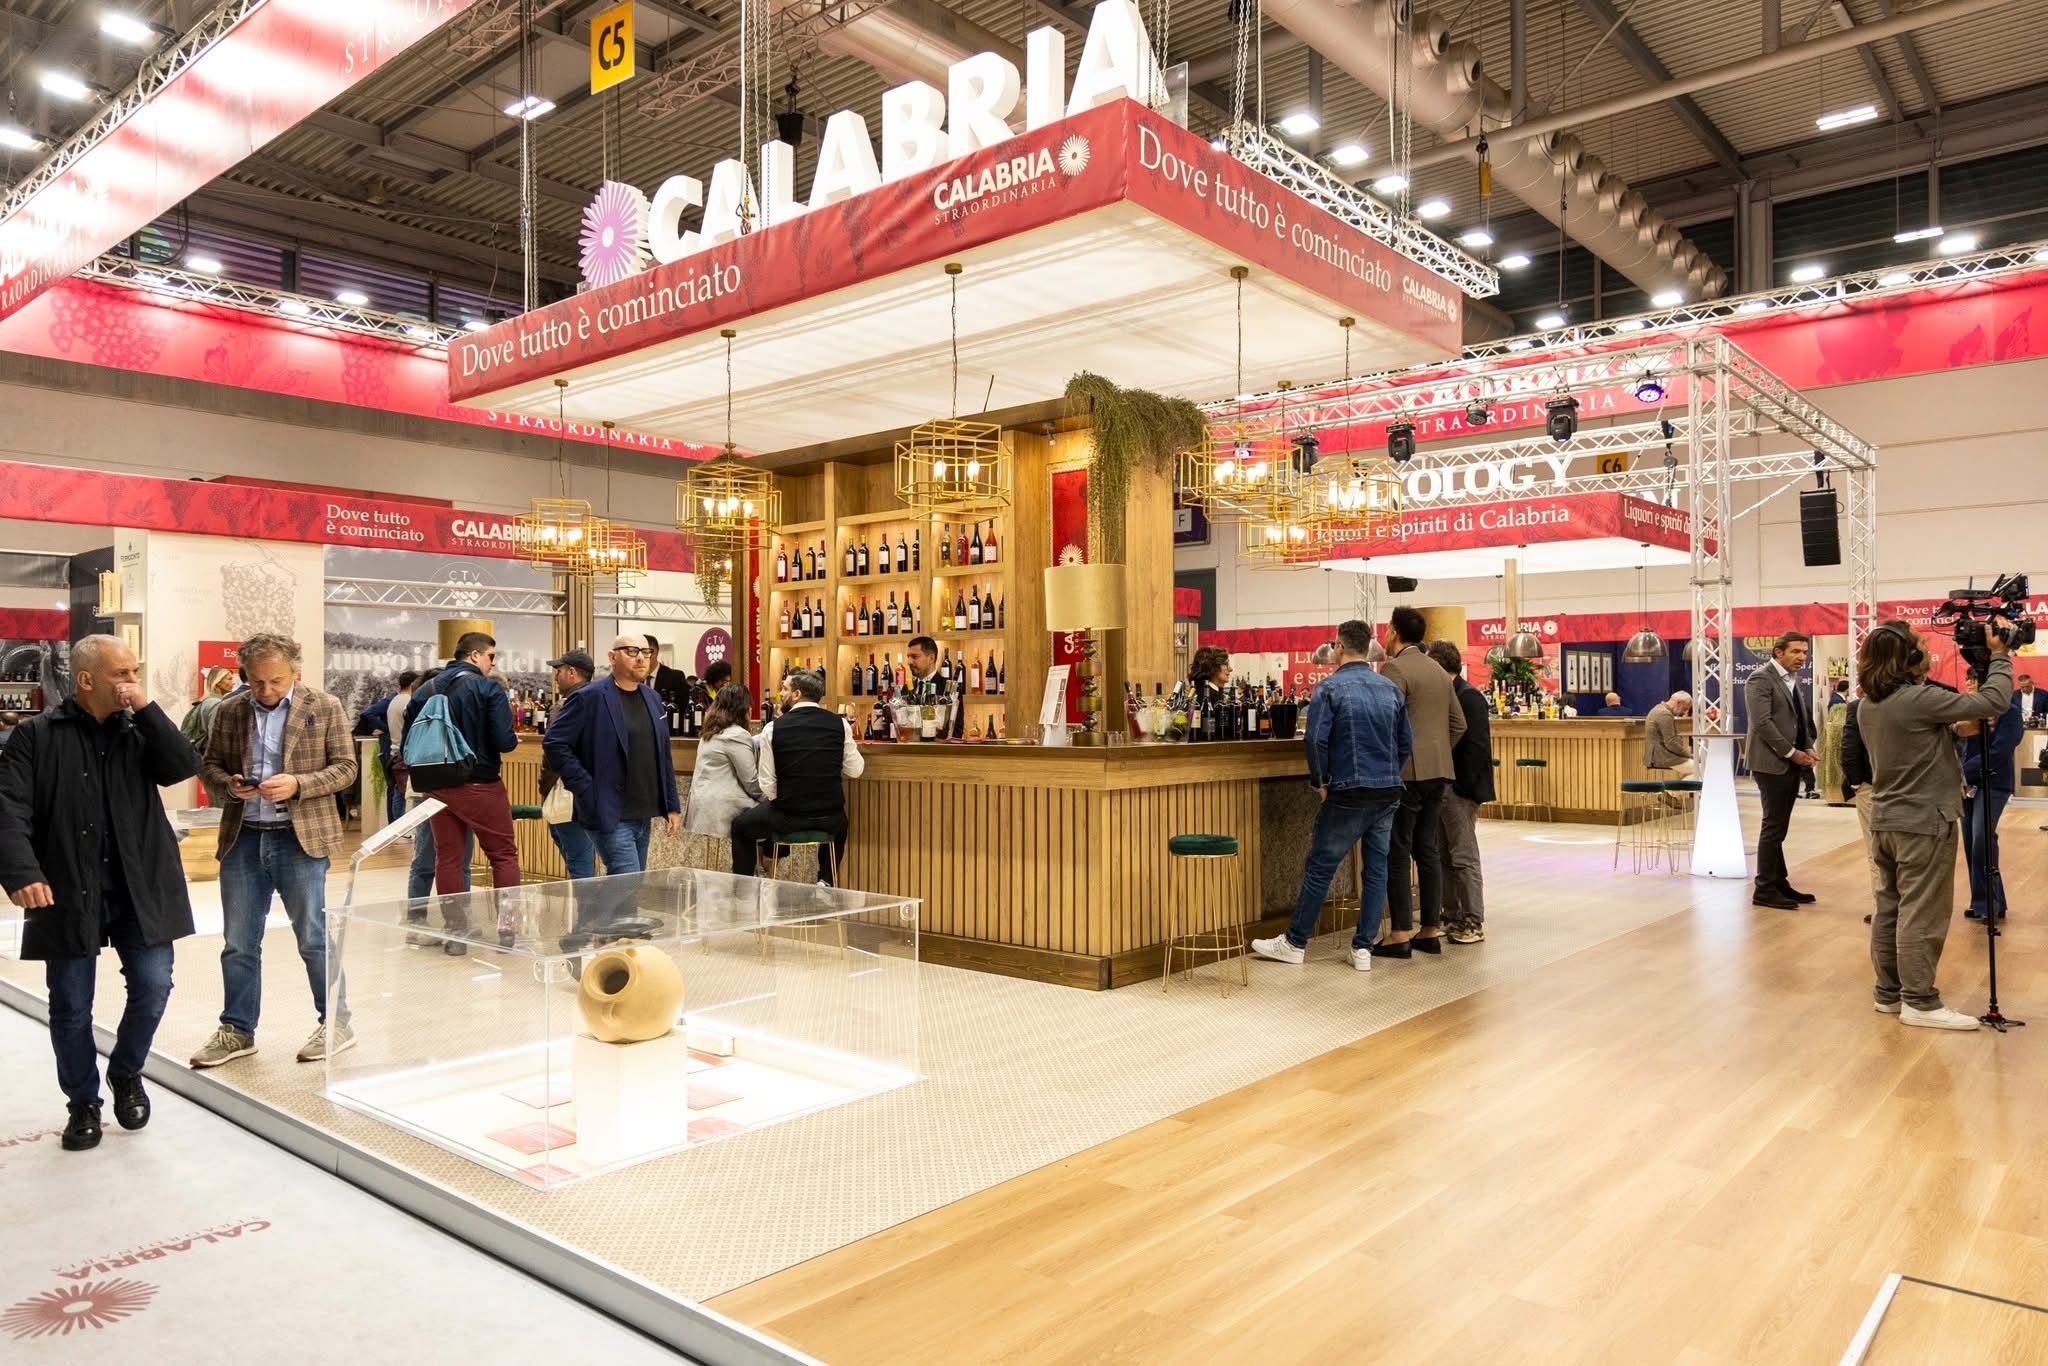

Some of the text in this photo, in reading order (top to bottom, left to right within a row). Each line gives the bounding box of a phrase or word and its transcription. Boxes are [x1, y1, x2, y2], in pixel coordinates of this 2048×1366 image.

[598, 25, 626, 70] C5
[648, 0, 1168, 264] CALABRIA
[934, 148, 1056, 210] CALABRIA
[935, 176, 1057, 226] STRAORDINARIA
[1137, 124, 1392, 292] Dove tutto è cominciato
[1402, 275, 1447, 313] CALABRIA
[462, 263, 741, 377] Dove tutto è cominciato
[1420, 394, 1617, 435] TRARDINIA
[1602, 458, 1622, 474] C6
[326, 522, 424, 542] è cominciato
[327, 504, 410, 525] Dove tutto
[1376, 526, 1387, 537] e
[1391, 511, 1449, 541] spiriti
[1453, 507, 1474, 532] di
[1479, 505, 1569, 528] Calabria
[1624, 499, 1653, 527] Liquori
[1661, 511, 1682, 534] spiriti
[451, 538, 512, 550] STRAORDI
[1481, 622, 1541, 634] CALRIA
[1896, 605, 1929, 616] Dove
[1294, 672, 1303, 685] e
[56, 1220, 271, 1280] CALABRIA
